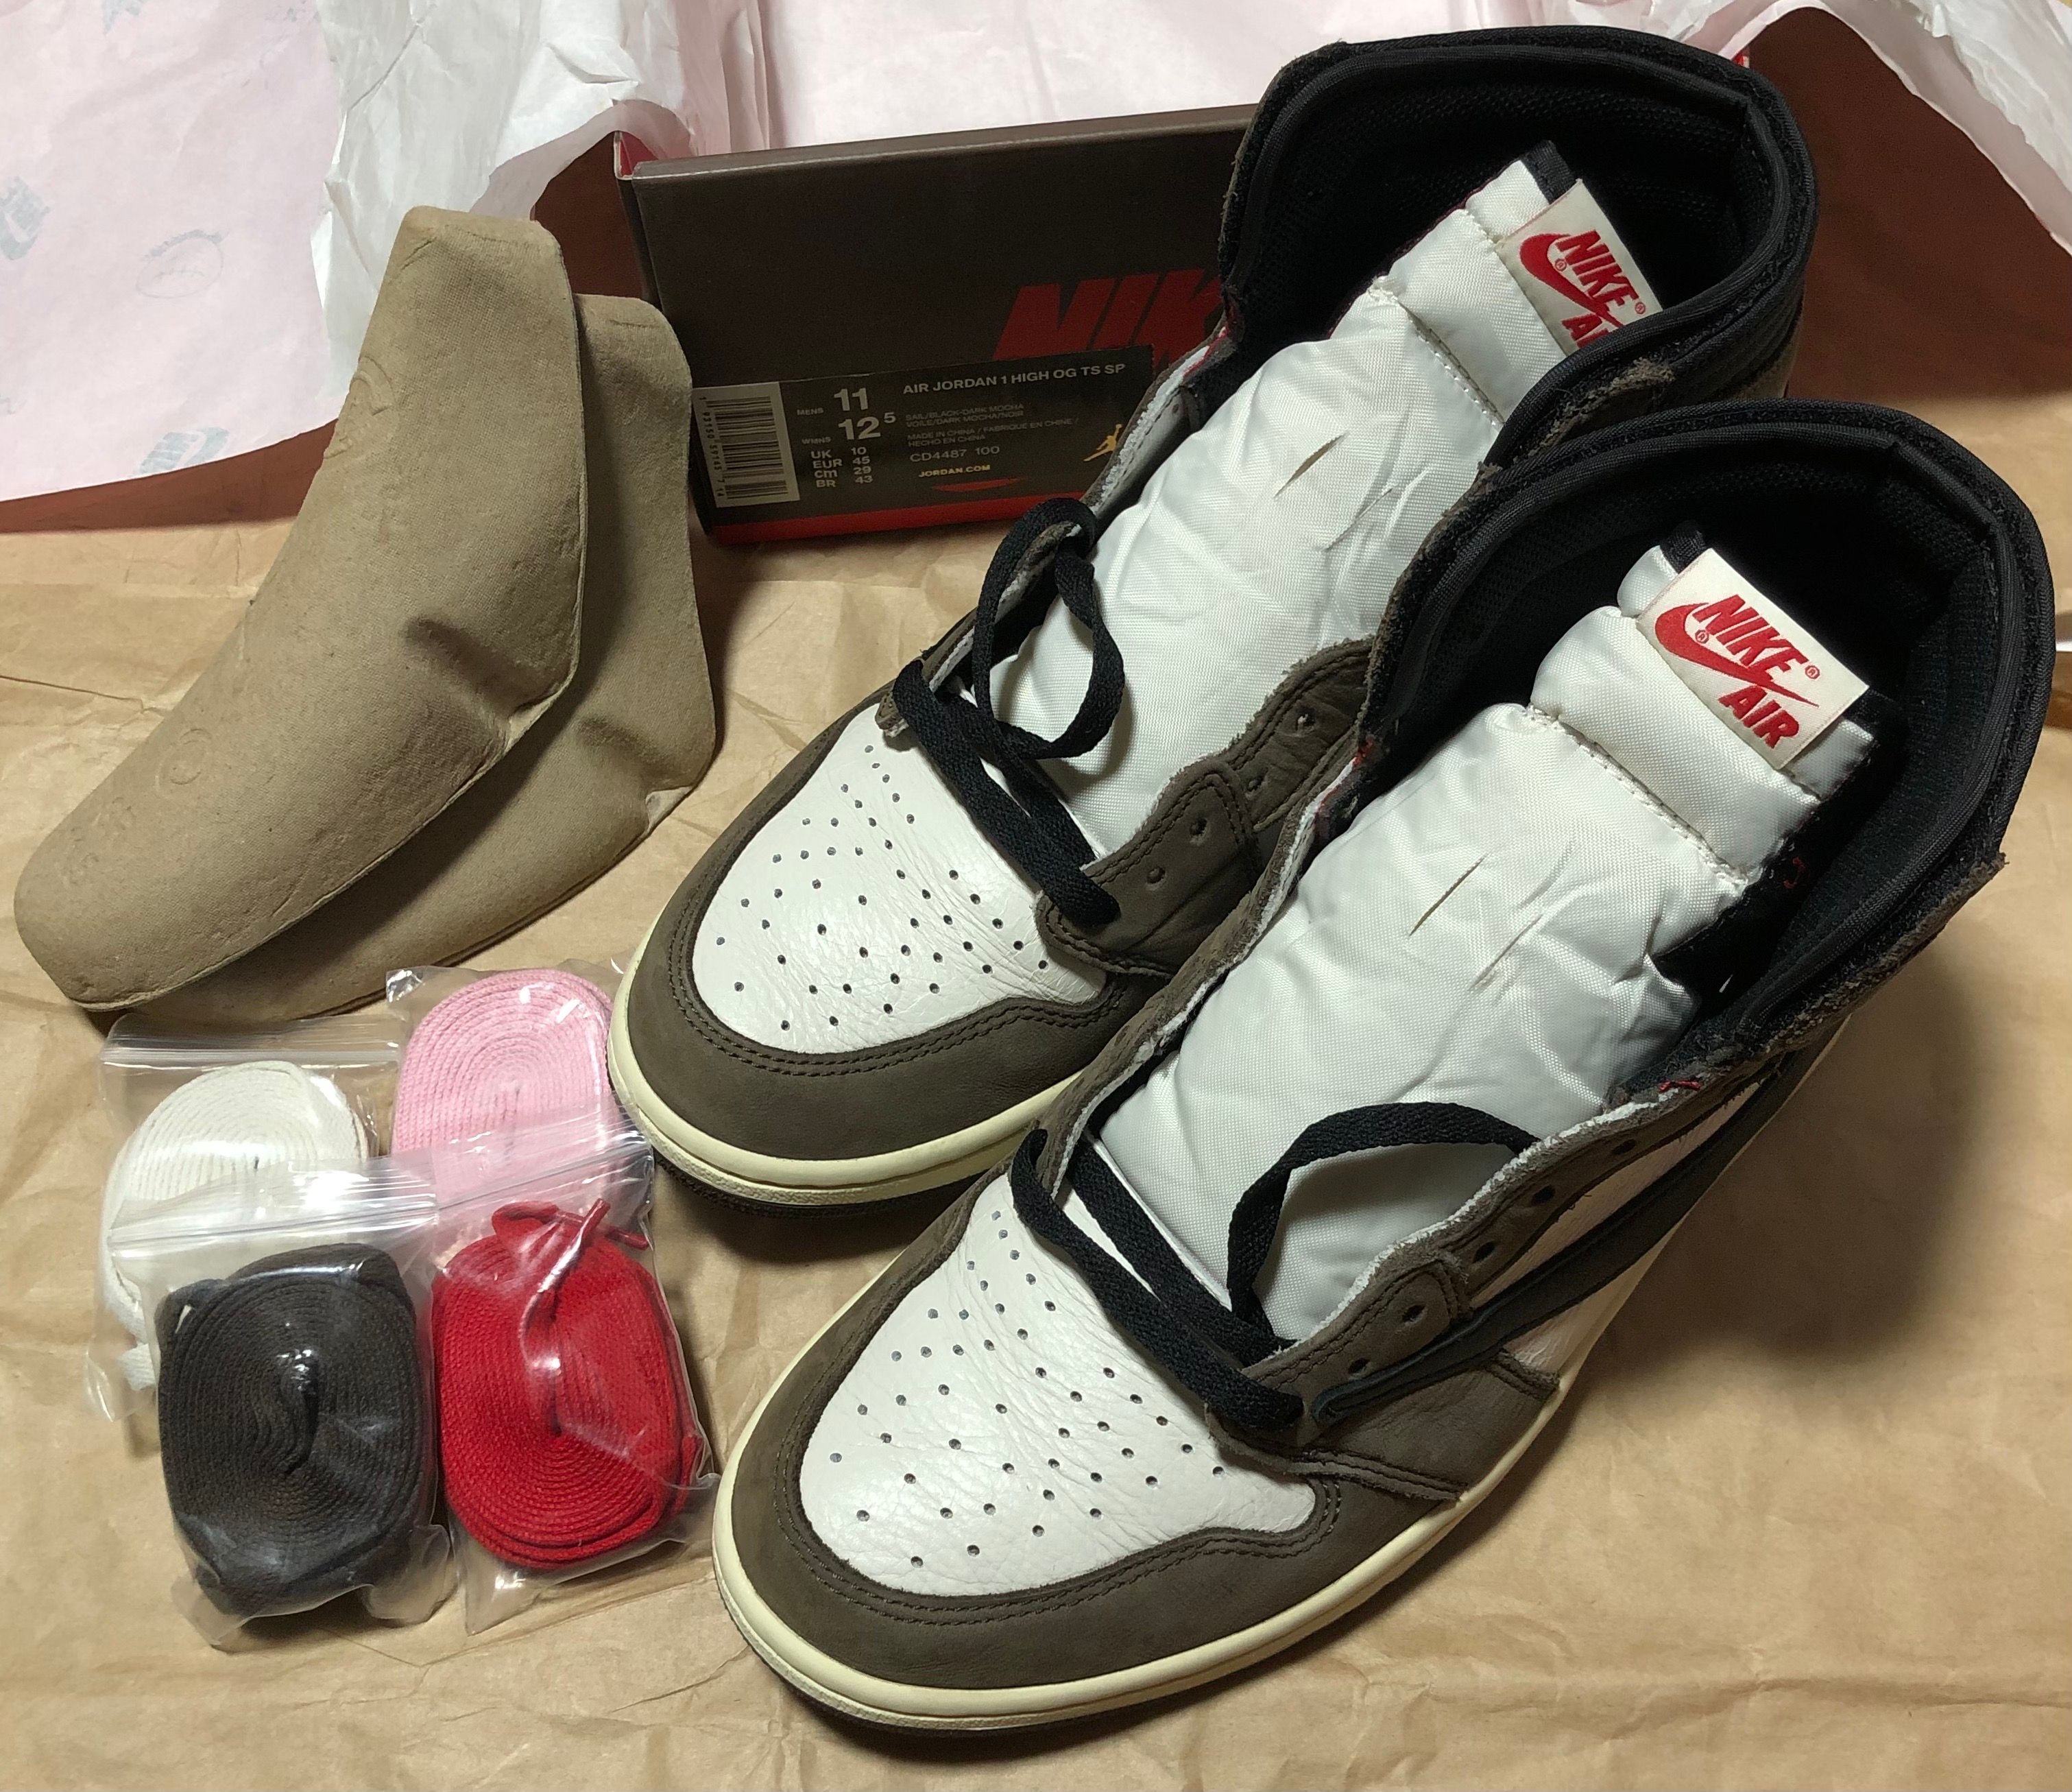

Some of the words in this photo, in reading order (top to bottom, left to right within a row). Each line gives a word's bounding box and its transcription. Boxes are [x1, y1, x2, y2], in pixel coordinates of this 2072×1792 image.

[1556, 230, 1639, 312] NIKE
[993, 268, 1223, 368] NIK
[1561, 313, 1609, 348] AI
[903, 383, 929, 394] AIR
[933, 377, 997, 391] JORDAN
[1001, 375, 1007, 384] 1
[1011, 370, 1049, 384] HIGH
[1053, 368, 1077, 379] OG
[1081, 366, 1100, 376] TS
[1105, 363, 1126, 374] SP
[834, 387, 868, 411] 11
[838, 417, 881, 440] 12
[884, 412, 896, 424] 5
[810, 450, 832, 459] UK
[851, 447, 867, 455] 10
[812, 459, 843, 468] EUR
[852, 456, 870, 465] 45
[910, 449, 967, 462] CD4487
[975, 446, 1000, 455] 100
[816, 479, 836, 488] BR
[855, 475, 873, 483] 43
[854, 466, 871, 475] 29
[919, 464, 991, 478] JORDAN.COM
[1692, 594, 1809, 682] NIKE
[1718, 685, 1800, 749] AIR
